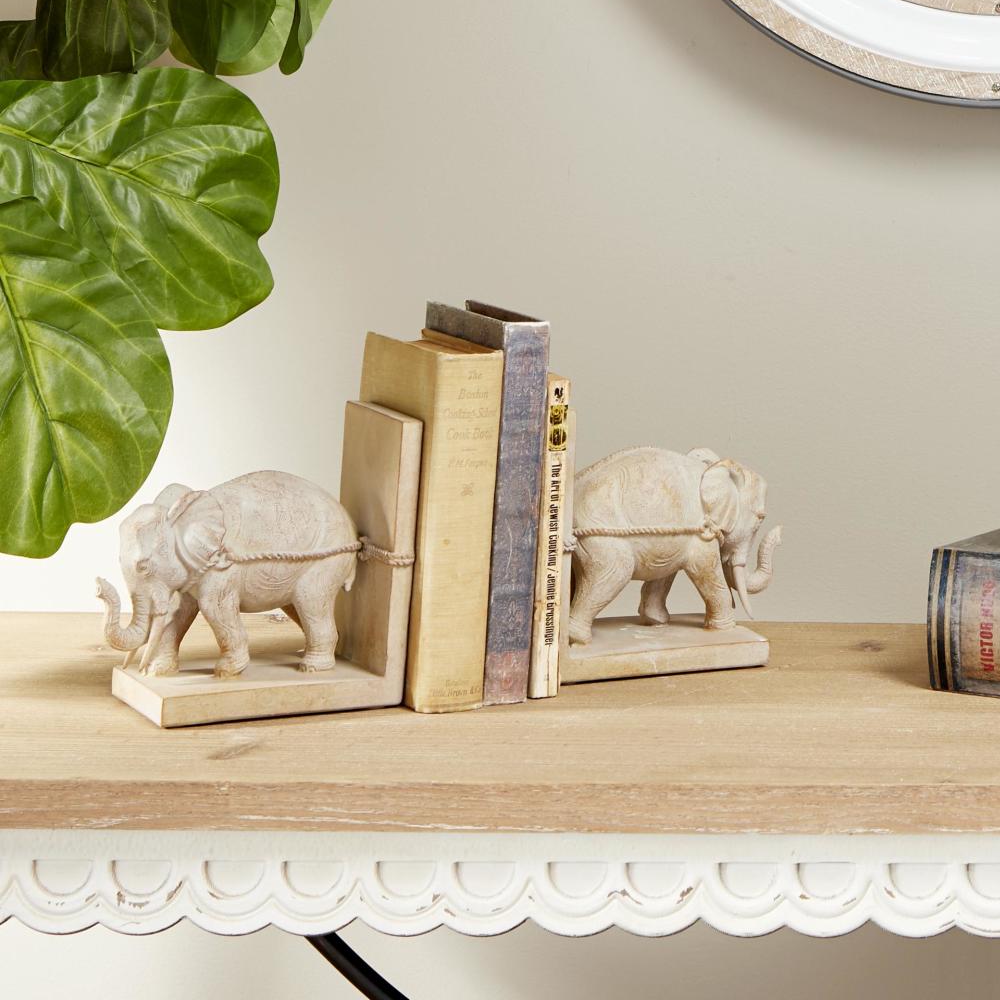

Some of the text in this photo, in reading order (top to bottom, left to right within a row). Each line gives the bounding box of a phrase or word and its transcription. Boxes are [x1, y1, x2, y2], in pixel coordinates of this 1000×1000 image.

[551, 463, 562, 478] The
[550, 480, 561, 494] Art
[548, 503, 561, 532] Jewish
[547, 533, 560, 567] Cooking
[545, 572, 559, 602] Jennie
[544, 602, 558, 647] Grossinger
[979, 623, 995, 672] VICTOR
